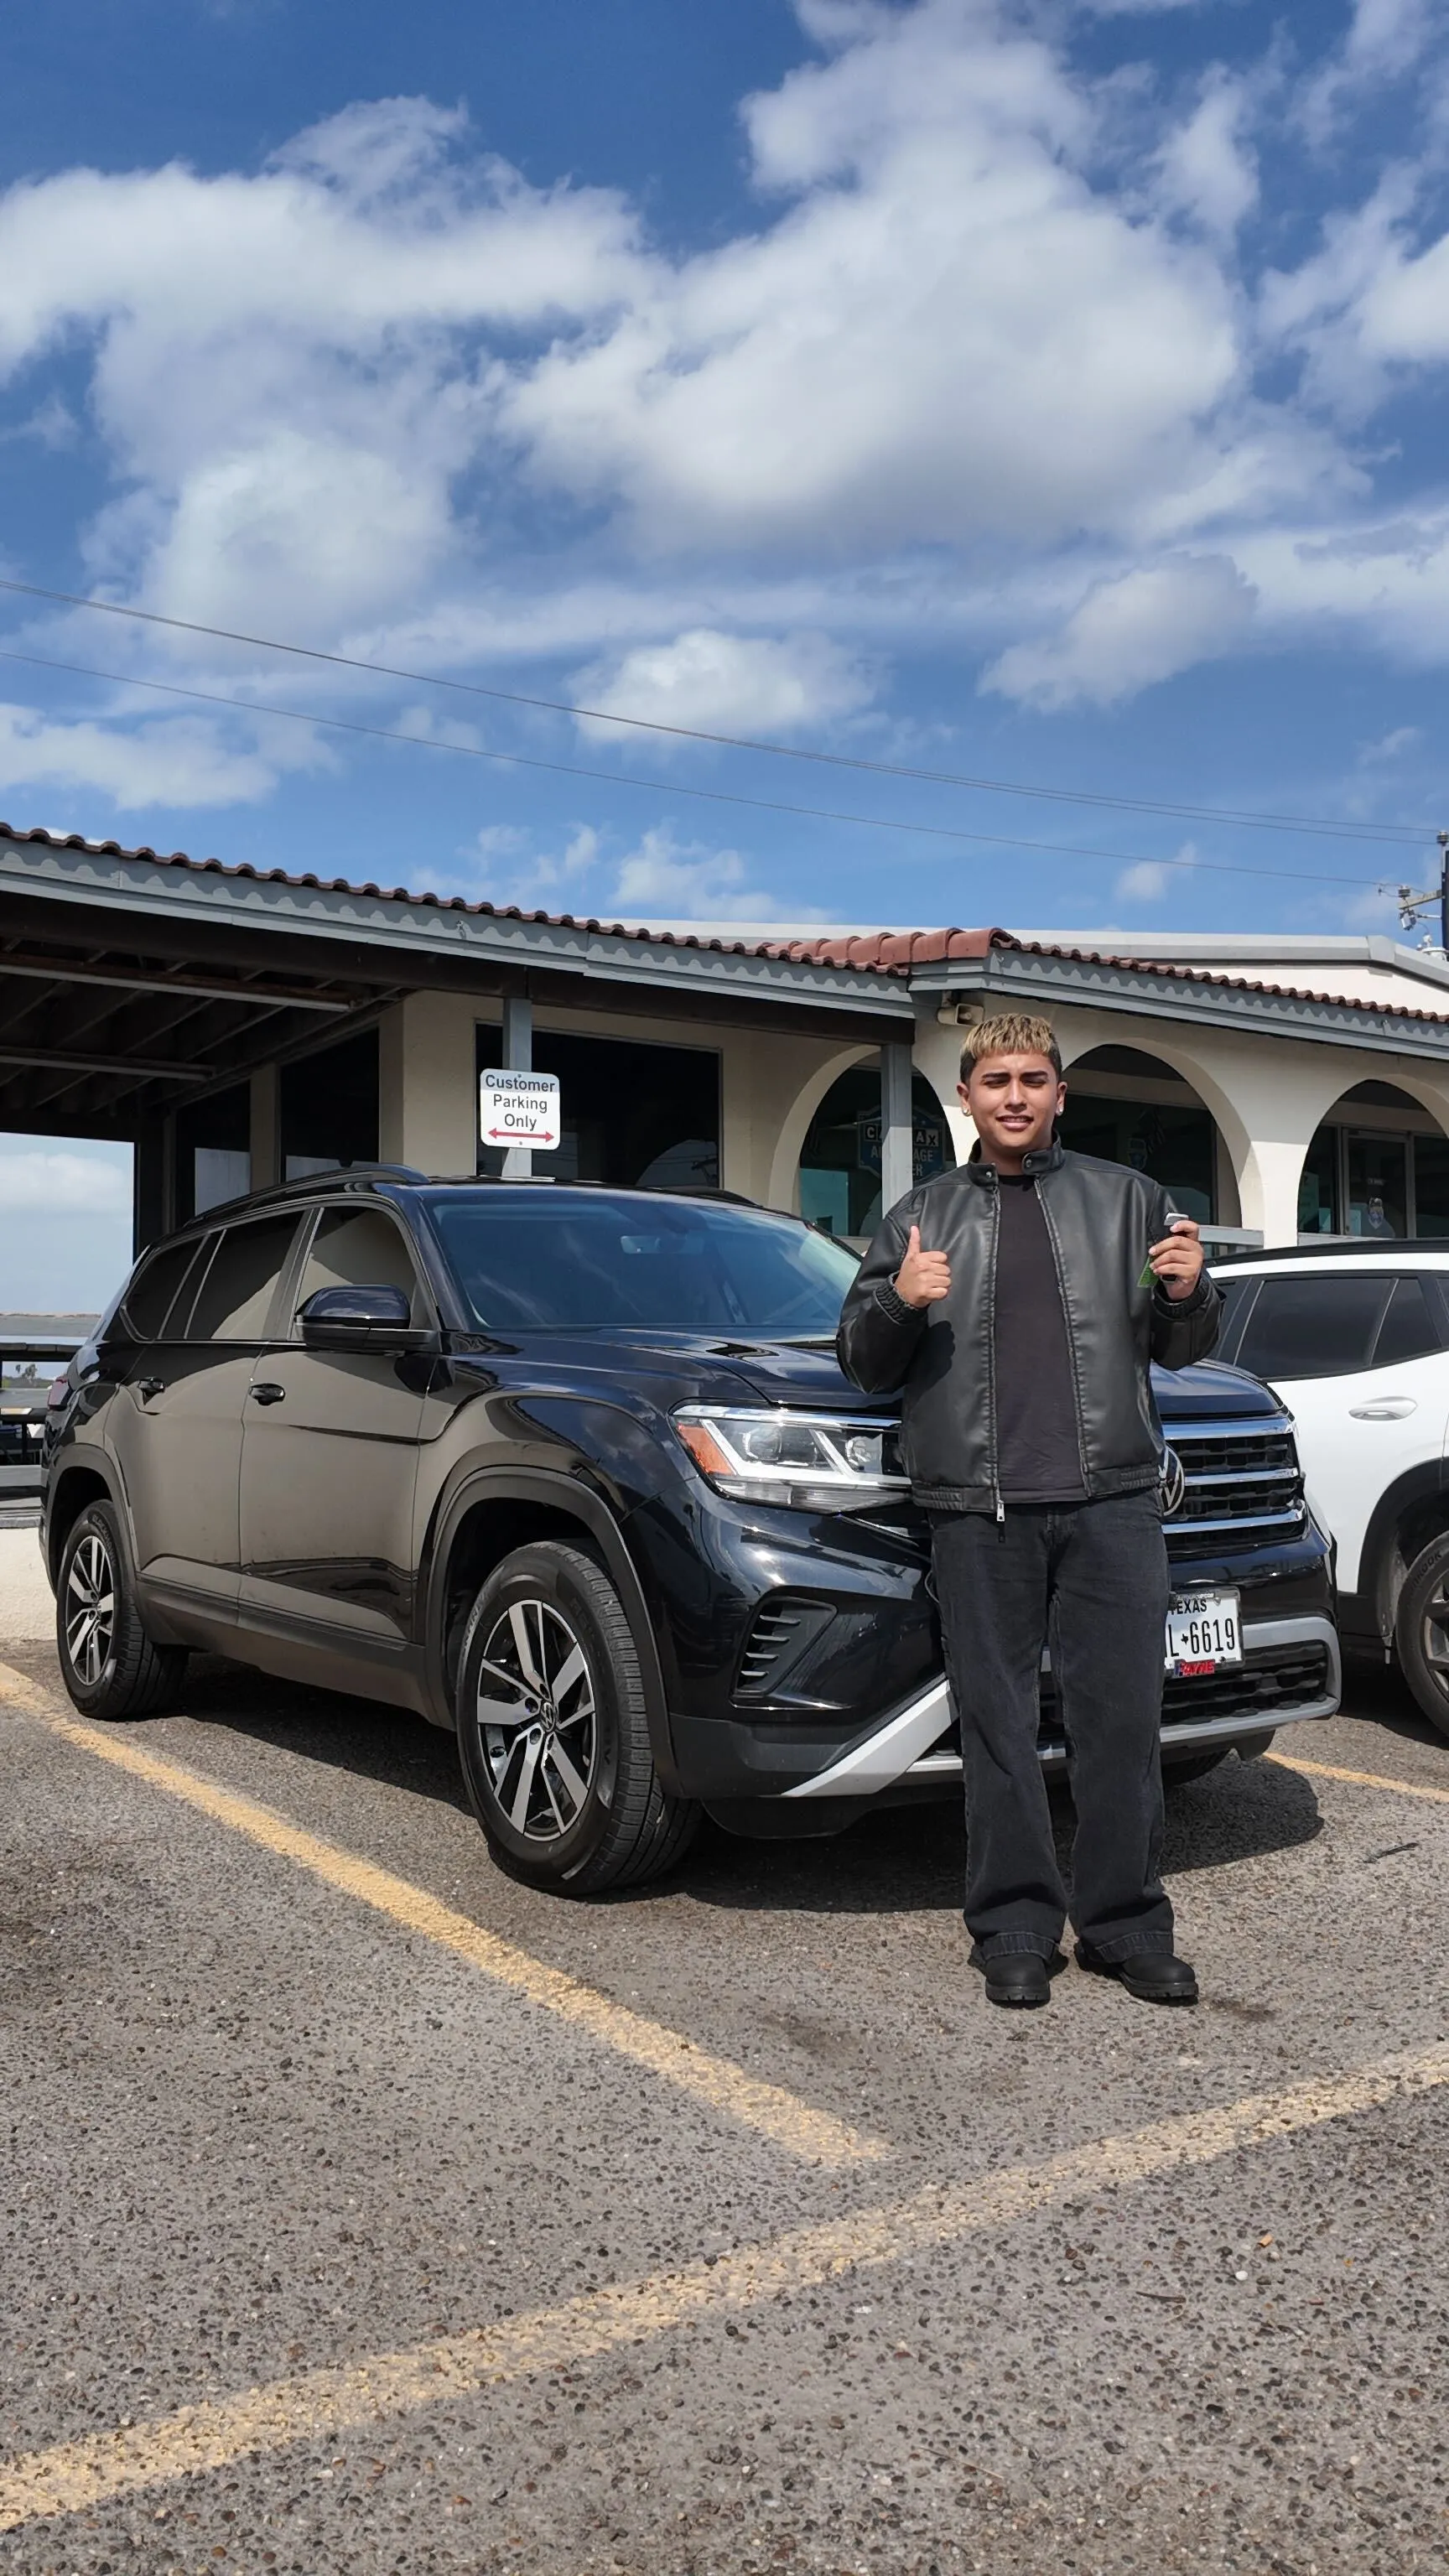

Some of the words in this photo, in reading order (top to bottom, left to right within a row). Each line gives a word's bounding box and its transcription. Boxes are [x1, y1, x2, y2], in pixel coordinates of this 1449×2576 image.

[486, 1074, 555, 1092] Customer
[493, 1093, 548, 1114] Parking
[504, 1114, 538, 1131] Only
[1189, 1618, 1235, 1654] 6619
